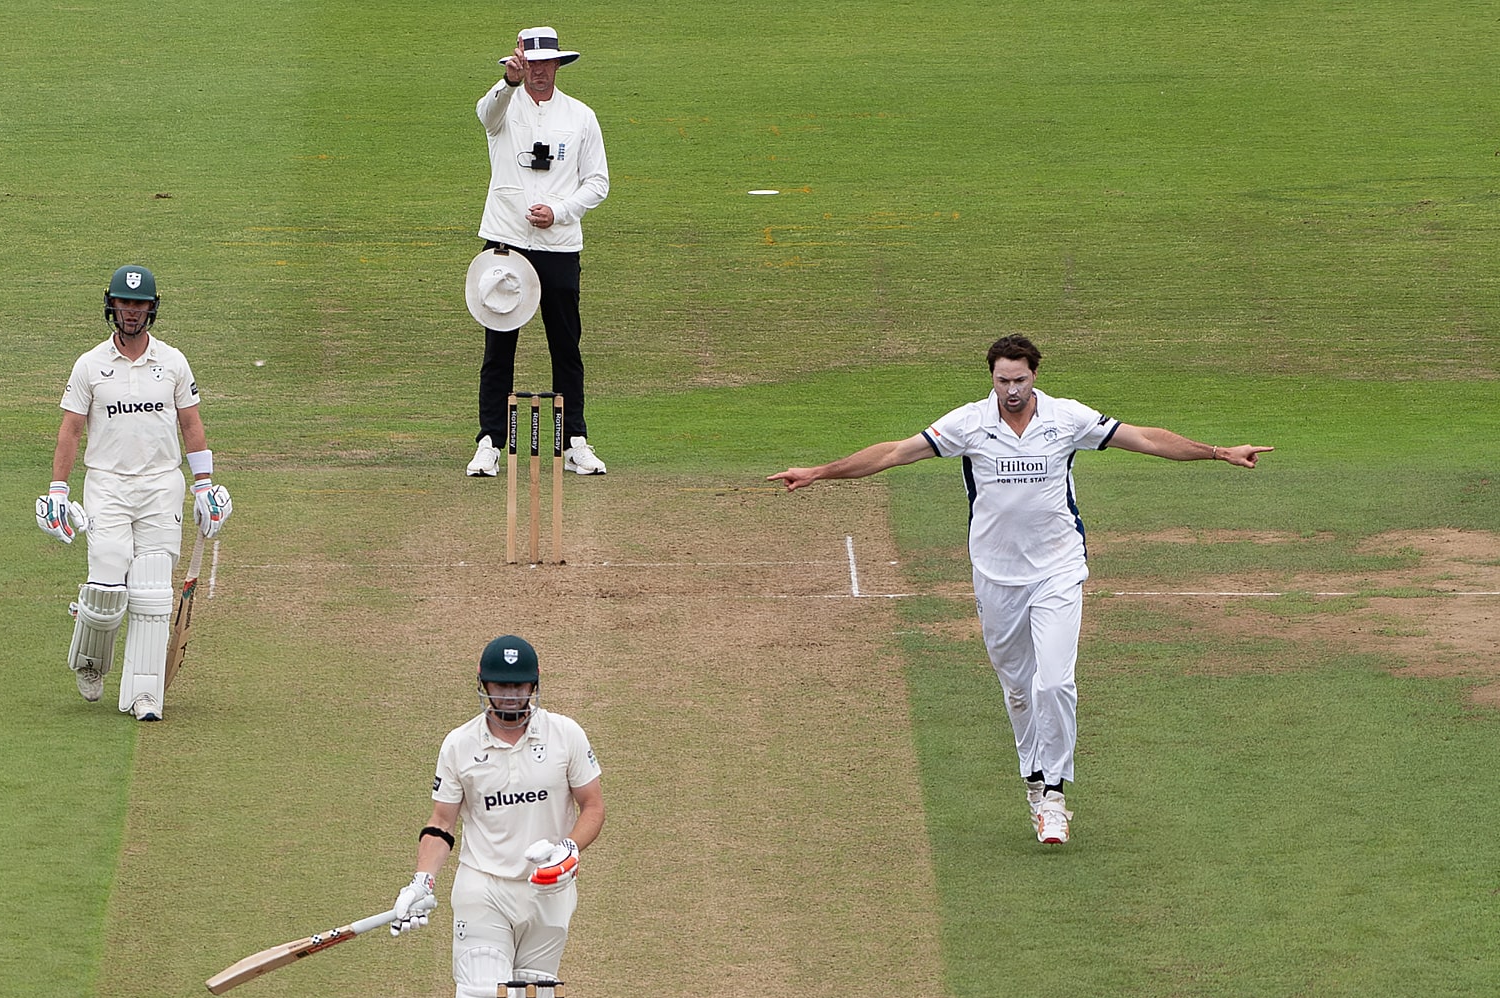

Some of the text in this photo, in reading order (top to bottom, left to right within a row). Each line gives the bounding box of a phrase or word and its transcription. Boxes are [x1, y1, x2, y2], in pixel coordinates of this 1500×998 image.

[106, 401, 164, 418] pluxee
[1000, 460, 1043, 472] Hilton
[484, 789, 548, 811] pluxee
